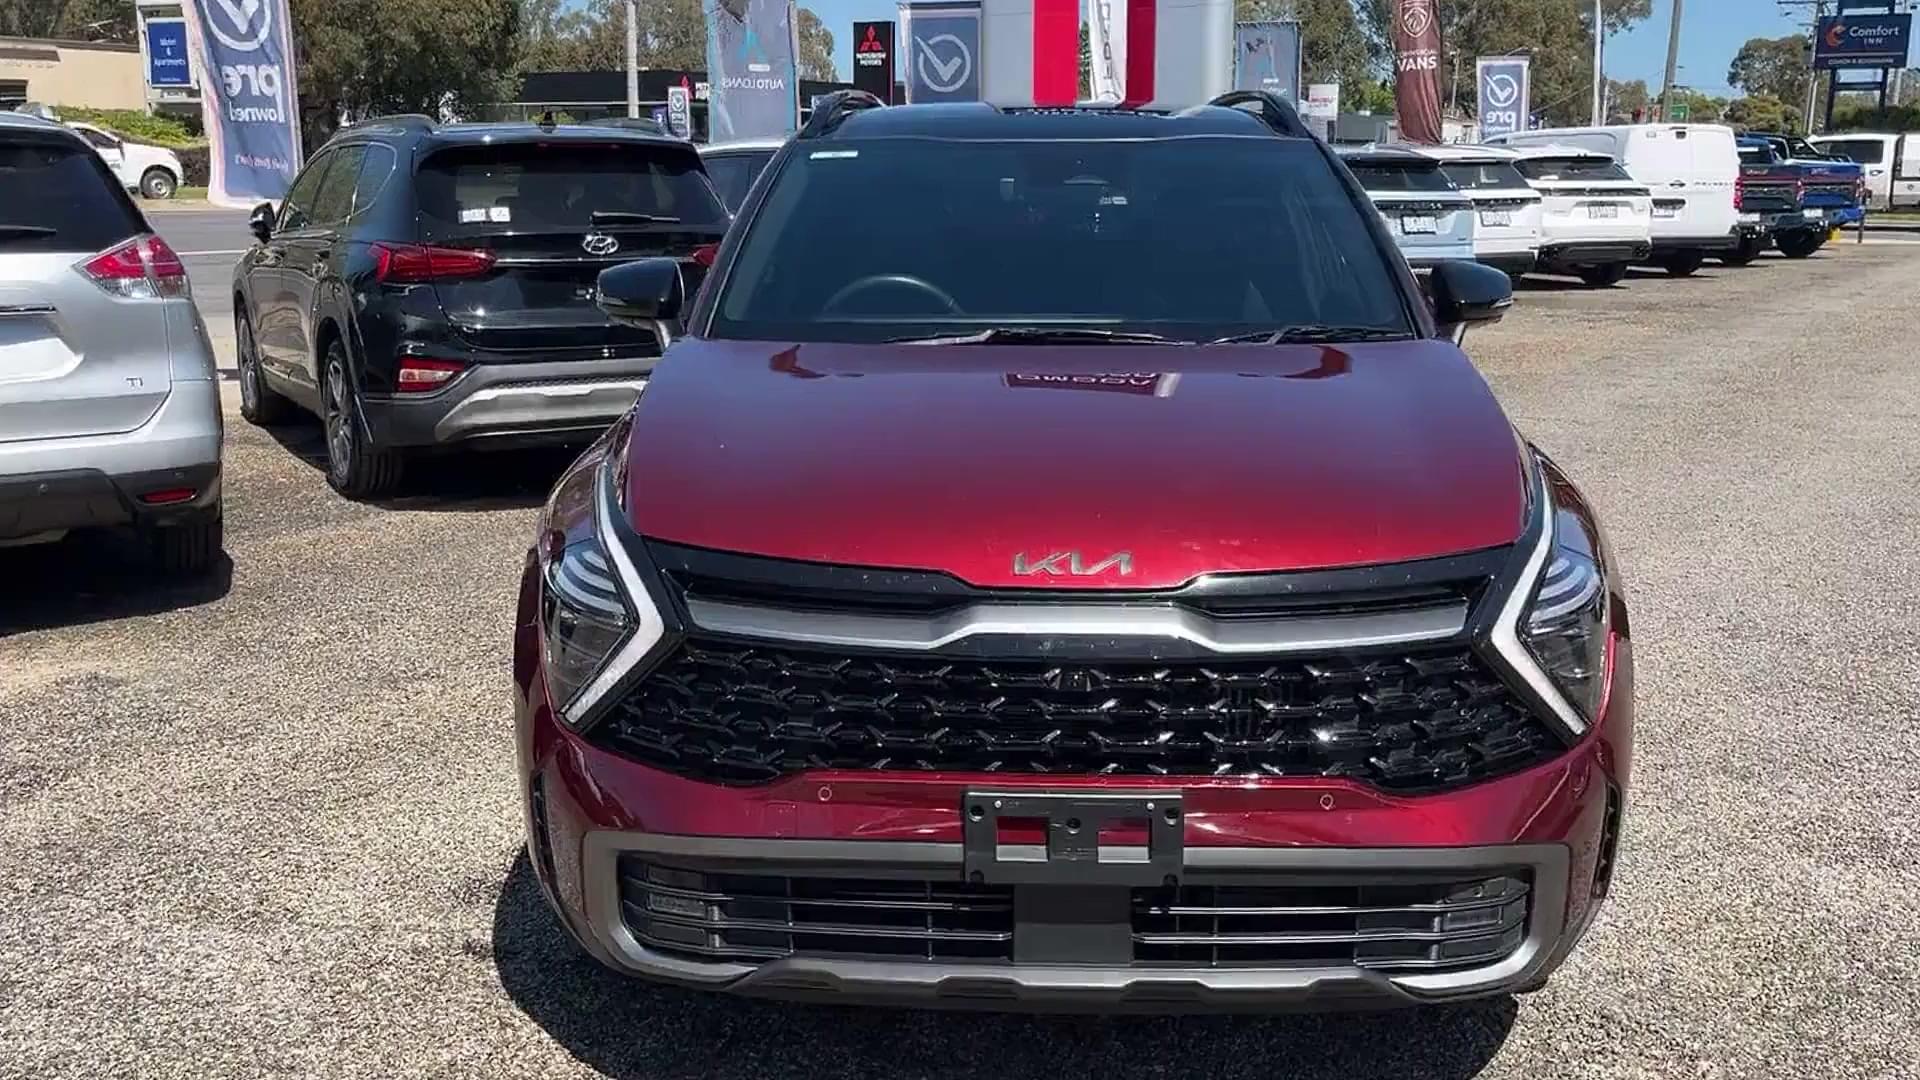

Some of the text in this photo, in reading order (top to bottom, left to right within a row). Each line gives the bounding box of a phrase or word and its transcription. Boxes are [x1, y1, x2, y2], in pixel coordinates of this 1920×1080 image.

[1849, 25, 1899, 37] Comfort
[1397, 56, 1437, 72] VANS
[1014, 551, 1132, 576] KIA
